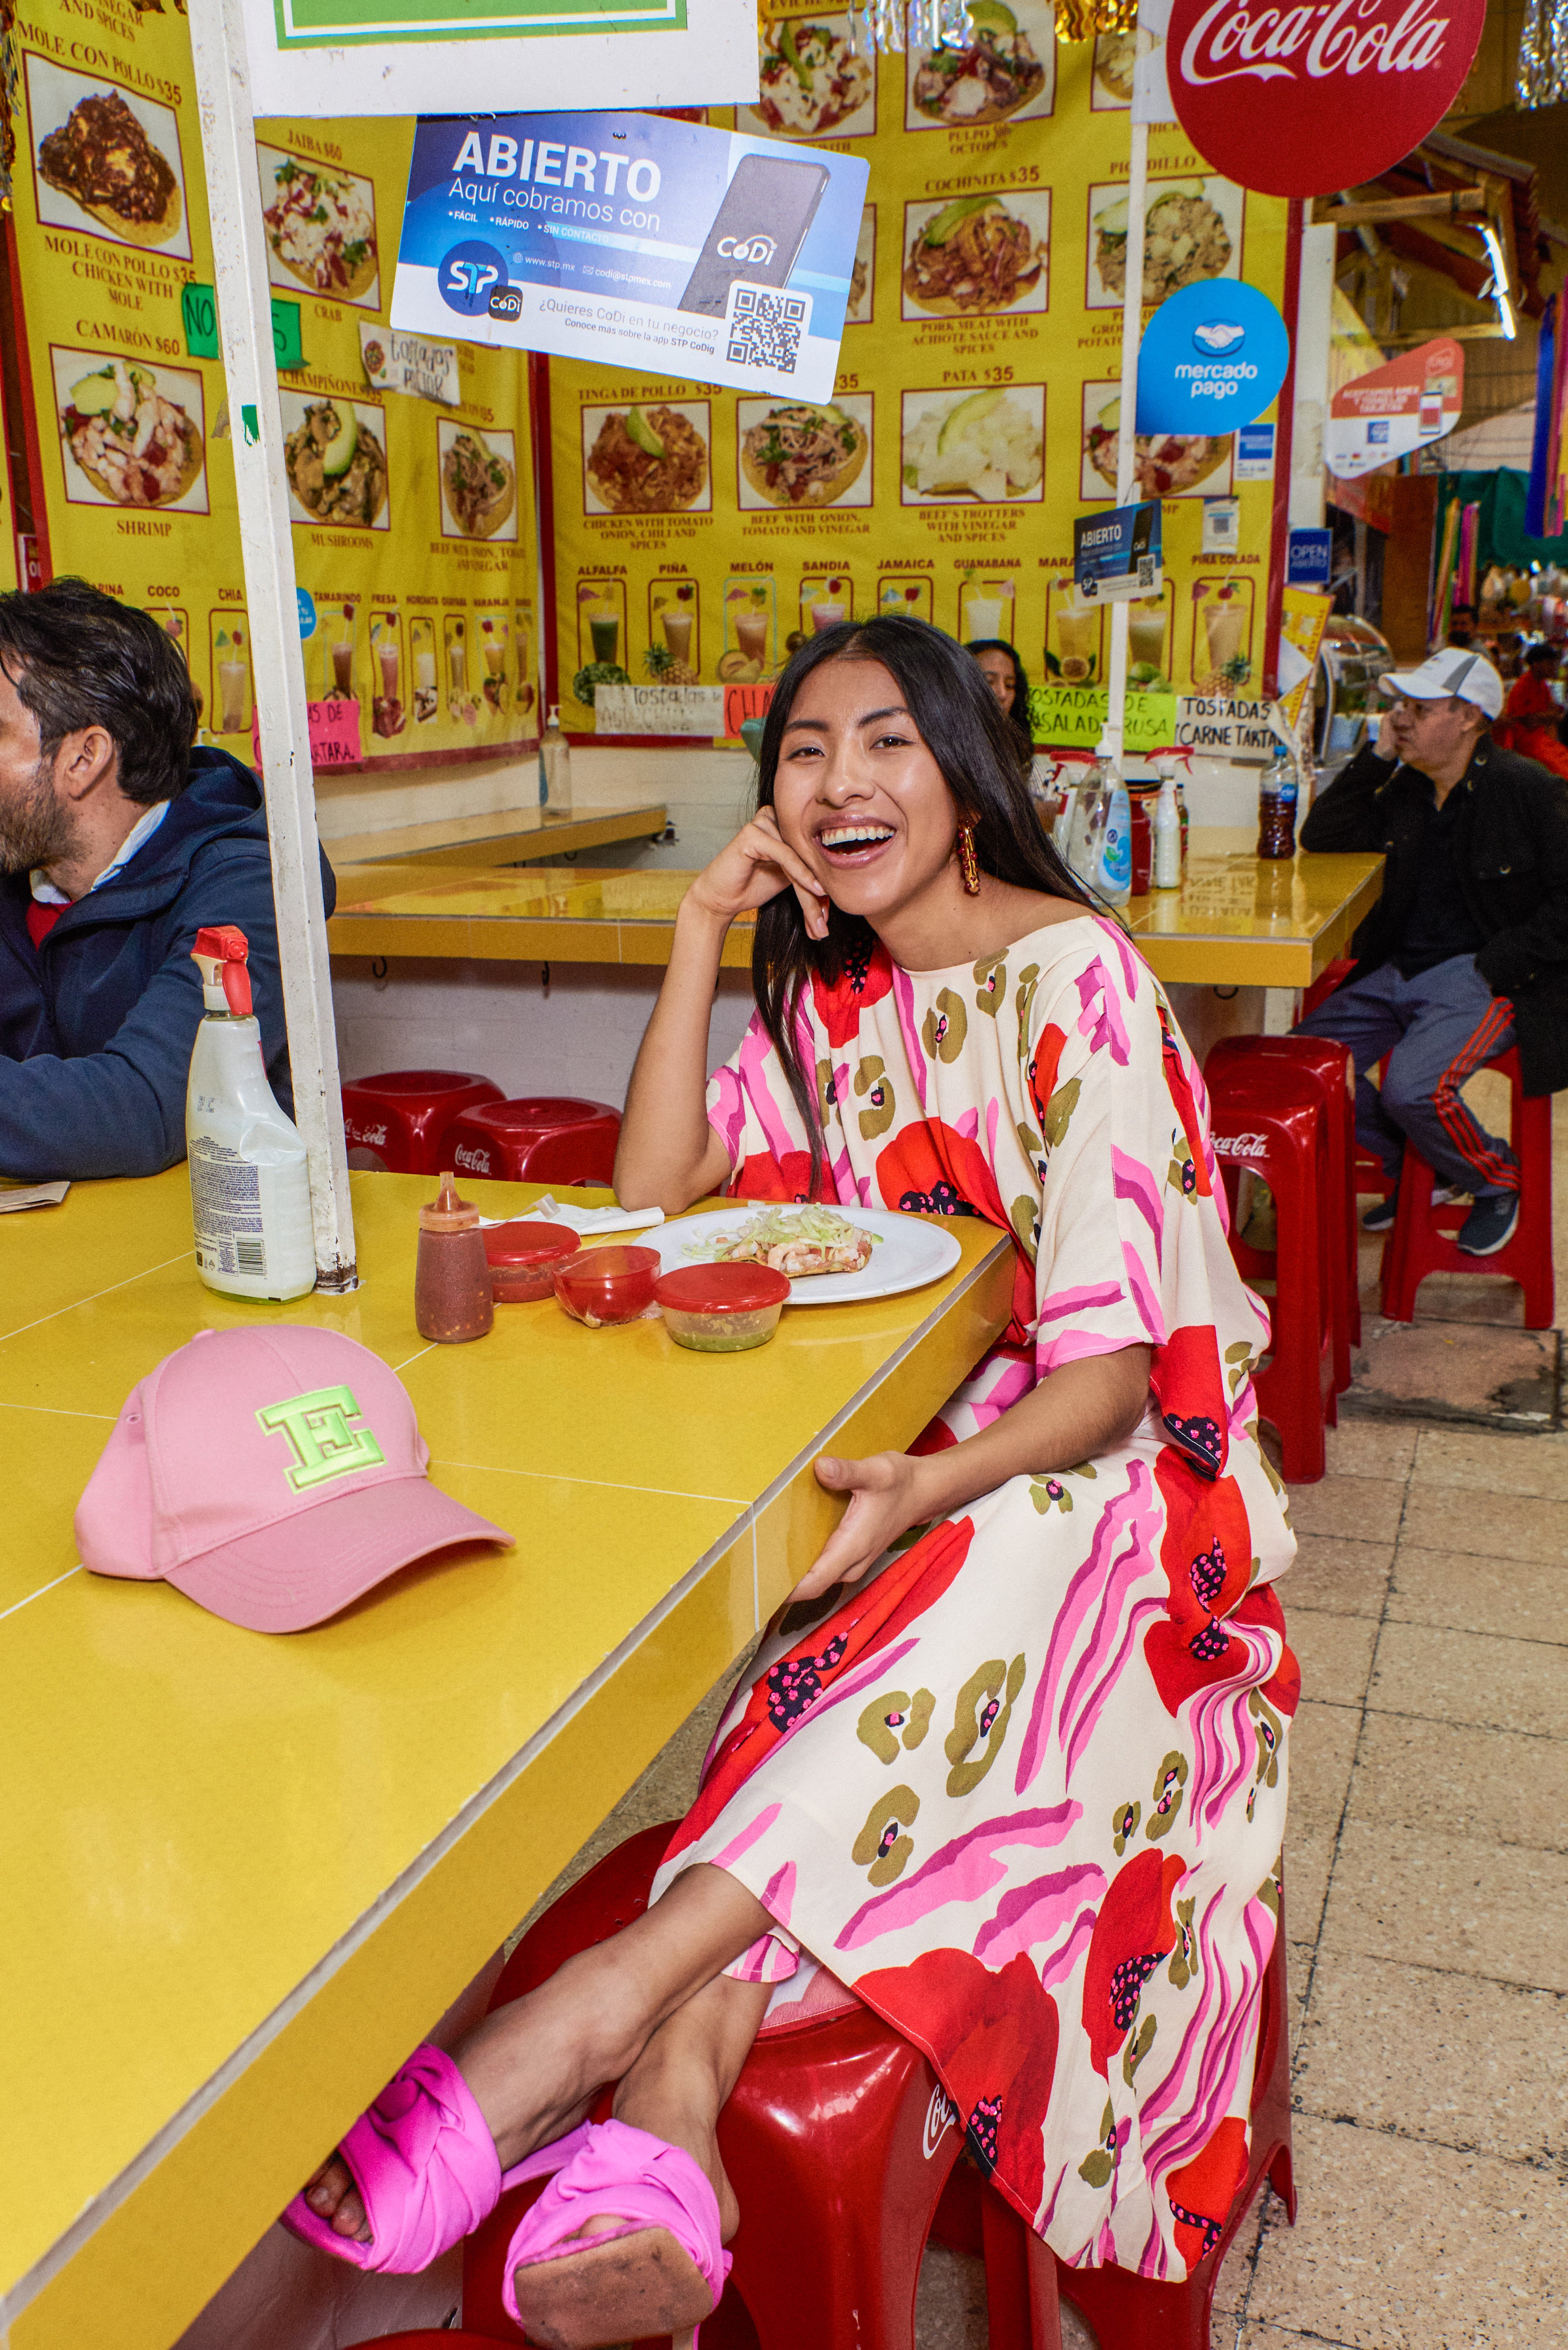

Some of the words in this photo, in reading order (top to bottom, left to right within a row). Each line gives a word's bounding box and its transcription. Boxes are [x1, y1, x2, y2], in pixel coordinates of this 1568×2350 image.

[60, 0, 94, 19] AND
[96, 8, 135, 43] SPICES
[18, 21, 65, 56] MOLE
[71, 42, 108, 68] CON
[113, 56, 155, 90] POLLO
[157, 78, 181, 105] $35
[452, 131, 661, 202] ABIERTO
[1110, 156, 1195, 174] PICDILLO
[925, 172, 1005, 193] COCHINITA
[1009, 165, 1039, 184] $35
[449, 177, 499, 206] Aquí
[503, 187, 612, 221] cobramos
[620, 209, 660, 232] con
[454, 209, 478, 222] FÁCIL
[495, 215, 529, 229] RÁPIDO
[544, 224, 559, 235] SIN
[562, 227, 609, 243] CONTACTO
[46, 235, 93, 258] MOLE
[95, 247, 121, 266] CON
[124, 255, 170, 279] POLLO
[173, 266, 196, 285] $35
[717, 235, 777, 266] CoDi
[526, 255, 575, 271] www.stp.mx
[73, 261, 132, 288] CHICKEN
[136, 277, 173, 298] WITH
[447, 260, 498, 295] STP
[595, 268, 671, 289] codi@stpmex.com
[109, 289, 143, 311] MOLE
[490, 294, 521, 313] CoDi
[539, 299, 593, 318] ¿Quieres
[597, 307, 625, 323] CoDi
[629, 316, 644, 325] en
[648, 318, 661, 330] tu
[663, 323, 718, 341] negocio?
[996, 317, 1028, 328] WITH
[76, 320, 152, 349] CAMARÓN
[156, 337, 180, 355] $60
[565, 318, 596, 331] Conoce
[598, 324, 616, 335] más
[618, 327, 641, 340] sobre
[643, 331, 651, 342] la
[654, 337, 669, 347] app
[671, 337, 687, 347] STP
[690, 341, 715, 354] CoDig
[943, 370, 977, 382] PATA
[984, 365, 1014, 382] $35
[1175, 363, 1258, 379] mercado
[578, 387, 617, 400] TINGA
[621, 386, 638, 399] DE
[642, 385, 686, 397] POLLO
[1191, 380, 1238, 400] pago
[117, 520, 172, 537] SHRIMP
[1081, 524, 1122, 549] ABIERTO
[578, 565, 627, 575] ALFALFA
[659, 562, 687, 574] PIÑA
[730, 561, 773, 572] MELÓN
[877, 559, 935, 570] JAMAICA
[954, 558, 1021, 569] GUANABANA
[148, 585, 179, 597] COCO
[218, 588, 243, 601] CHIA
[328, 703, 343, 722] DE
[1184, 697, 1271, 720] TOSTADAS
[1210, 1131, 1270, 1157] oca-Cola
[454, 1144, 492, 1175] Coca-Cola
[254, 1384, 388, 1495] E
